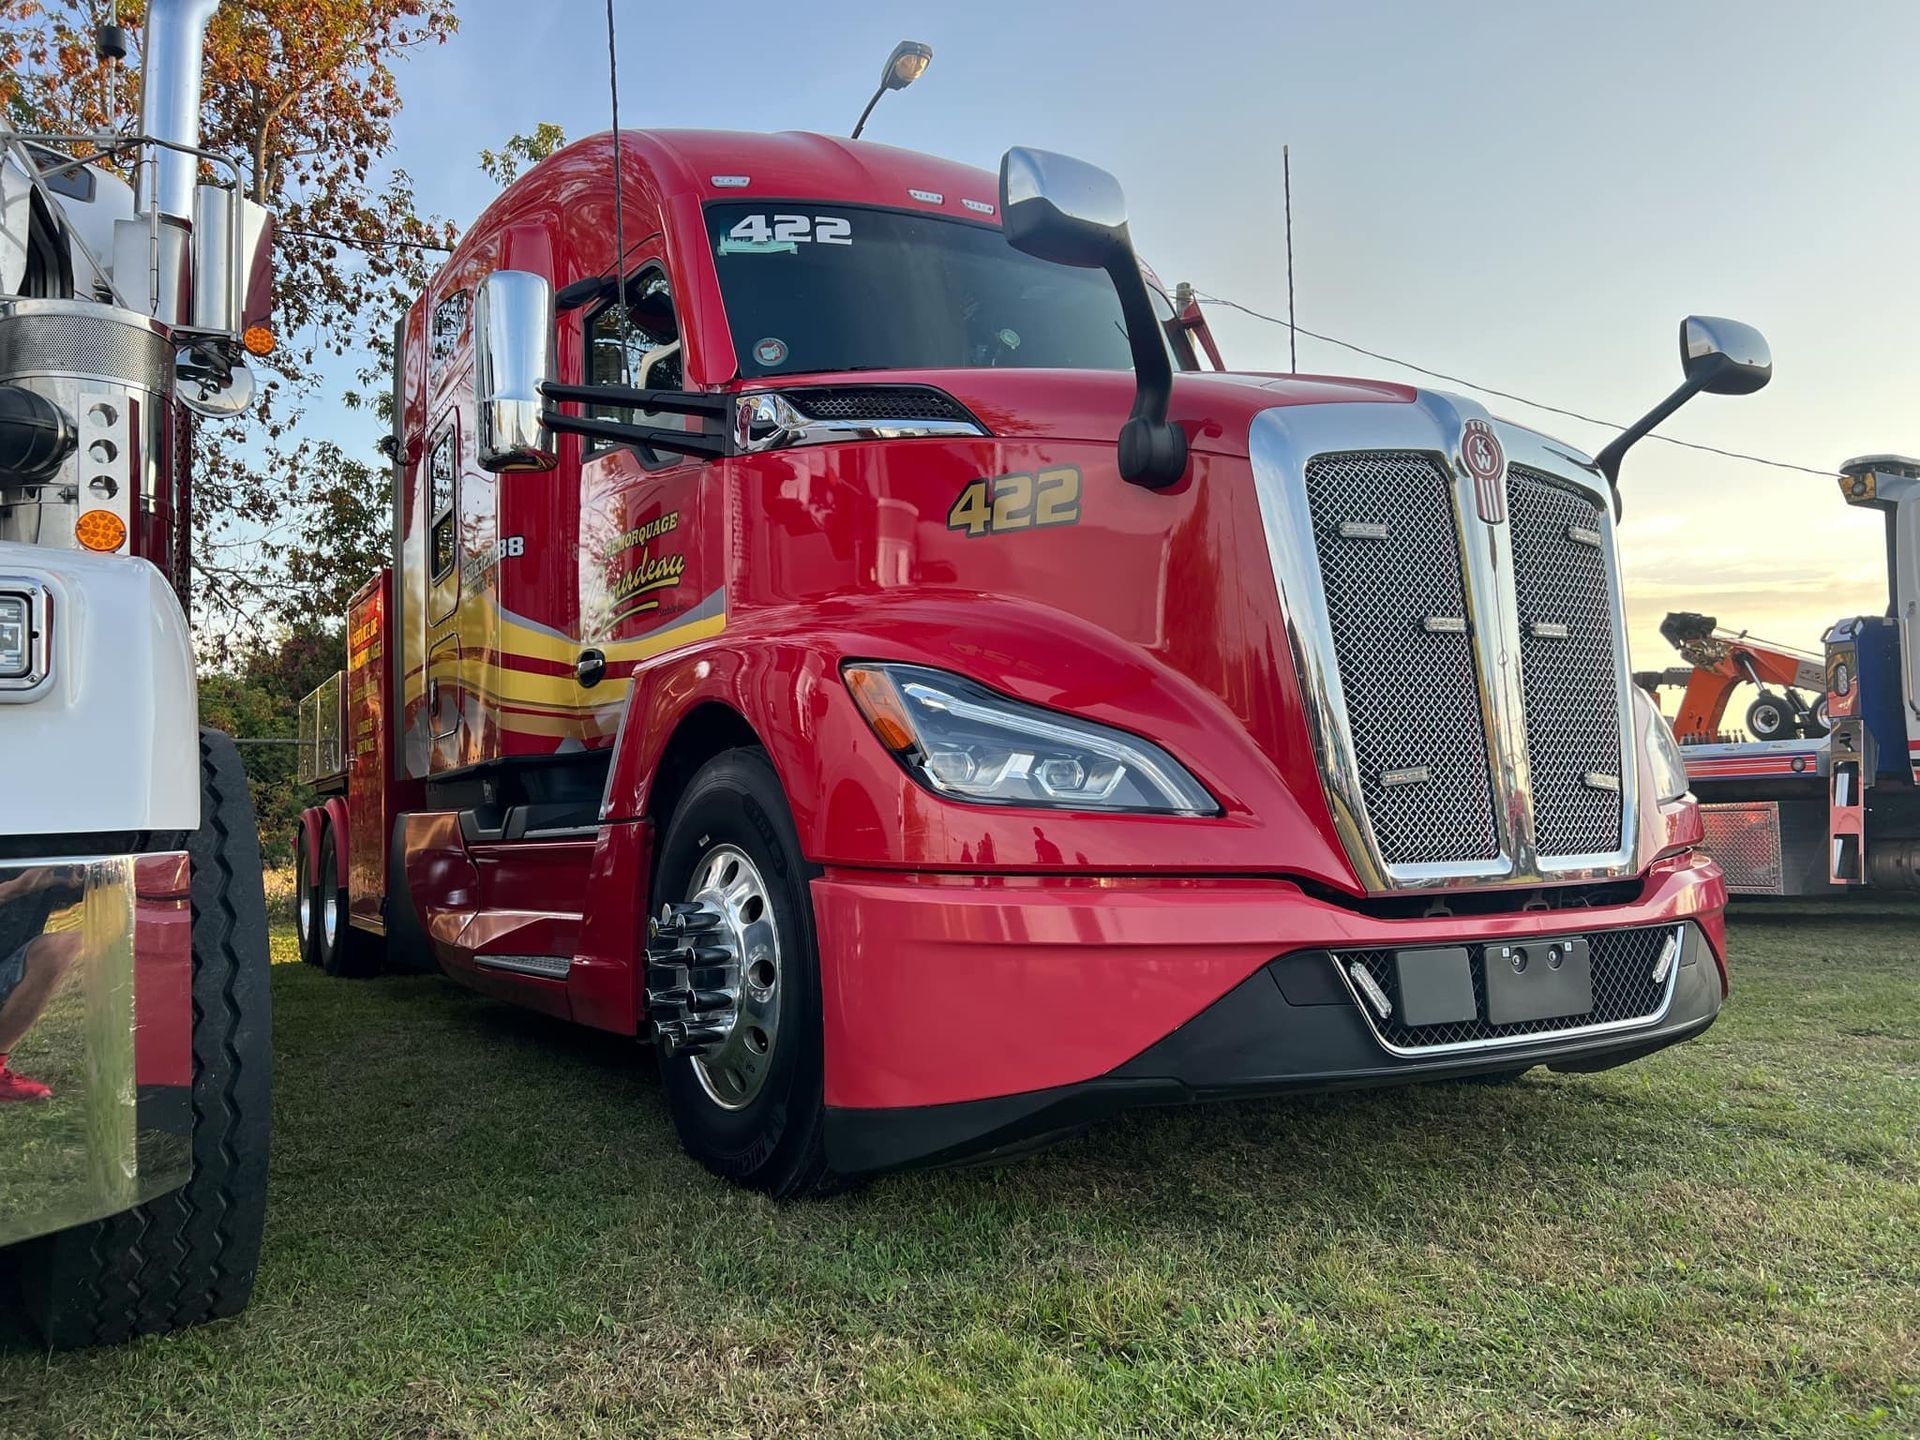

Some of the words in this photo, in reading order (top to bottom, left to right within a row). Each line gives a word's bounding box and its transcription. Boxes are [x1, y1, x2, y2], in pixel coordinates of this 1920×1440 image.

[729, 214, 853, 246] 422
[947, 465, 1081, 537] 422
[603, 511, 679, 559] REMORQUAGE
